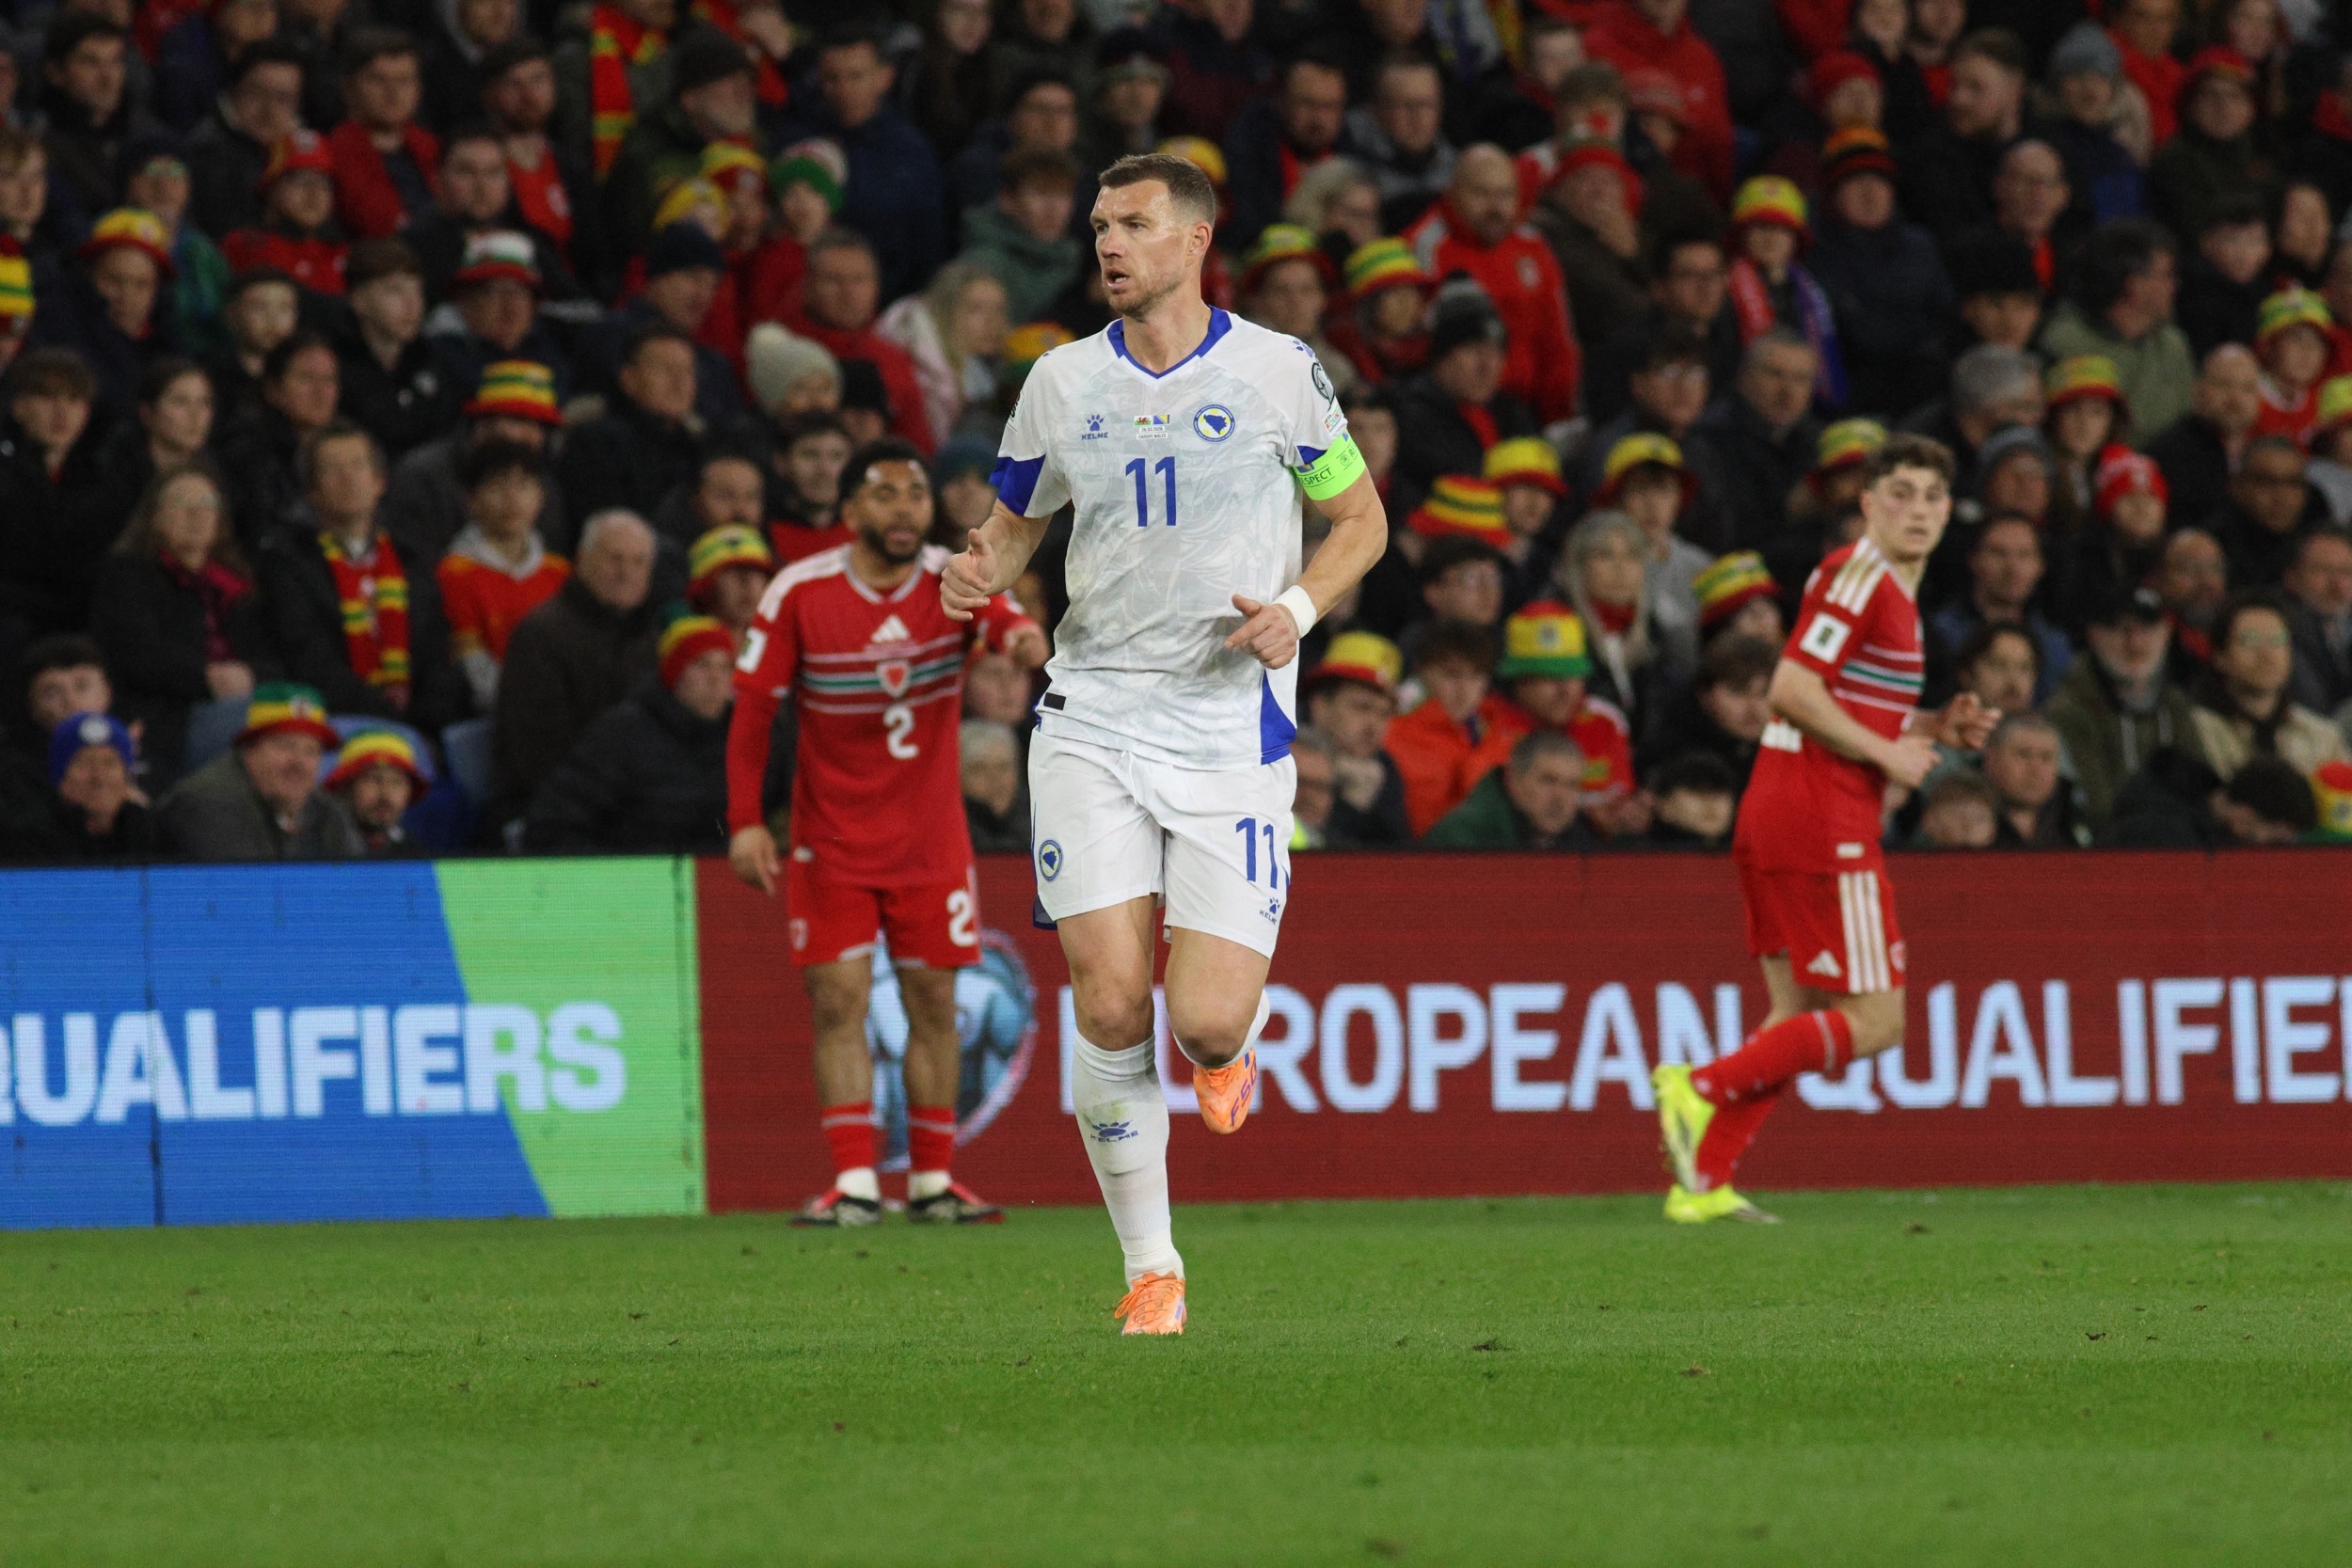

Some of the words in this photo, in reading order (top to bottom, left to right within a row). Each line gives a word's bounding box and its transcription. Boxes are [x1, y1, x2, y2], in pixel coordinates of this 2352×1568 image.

[1125, 456, 1176, 527] 11
[1300, 467, 1332, 485] ESPECT
[883, 705, 919, 760] 2
[1235, 817, 1278, 889] 11
[946, 889, 978, 947] 2
[0, 1001, 628, 1126] UALIFIERS
[1059, 982, 1742, 1115] ROPEAN
[1795, 975, 2352, 1114] UALIFIE
